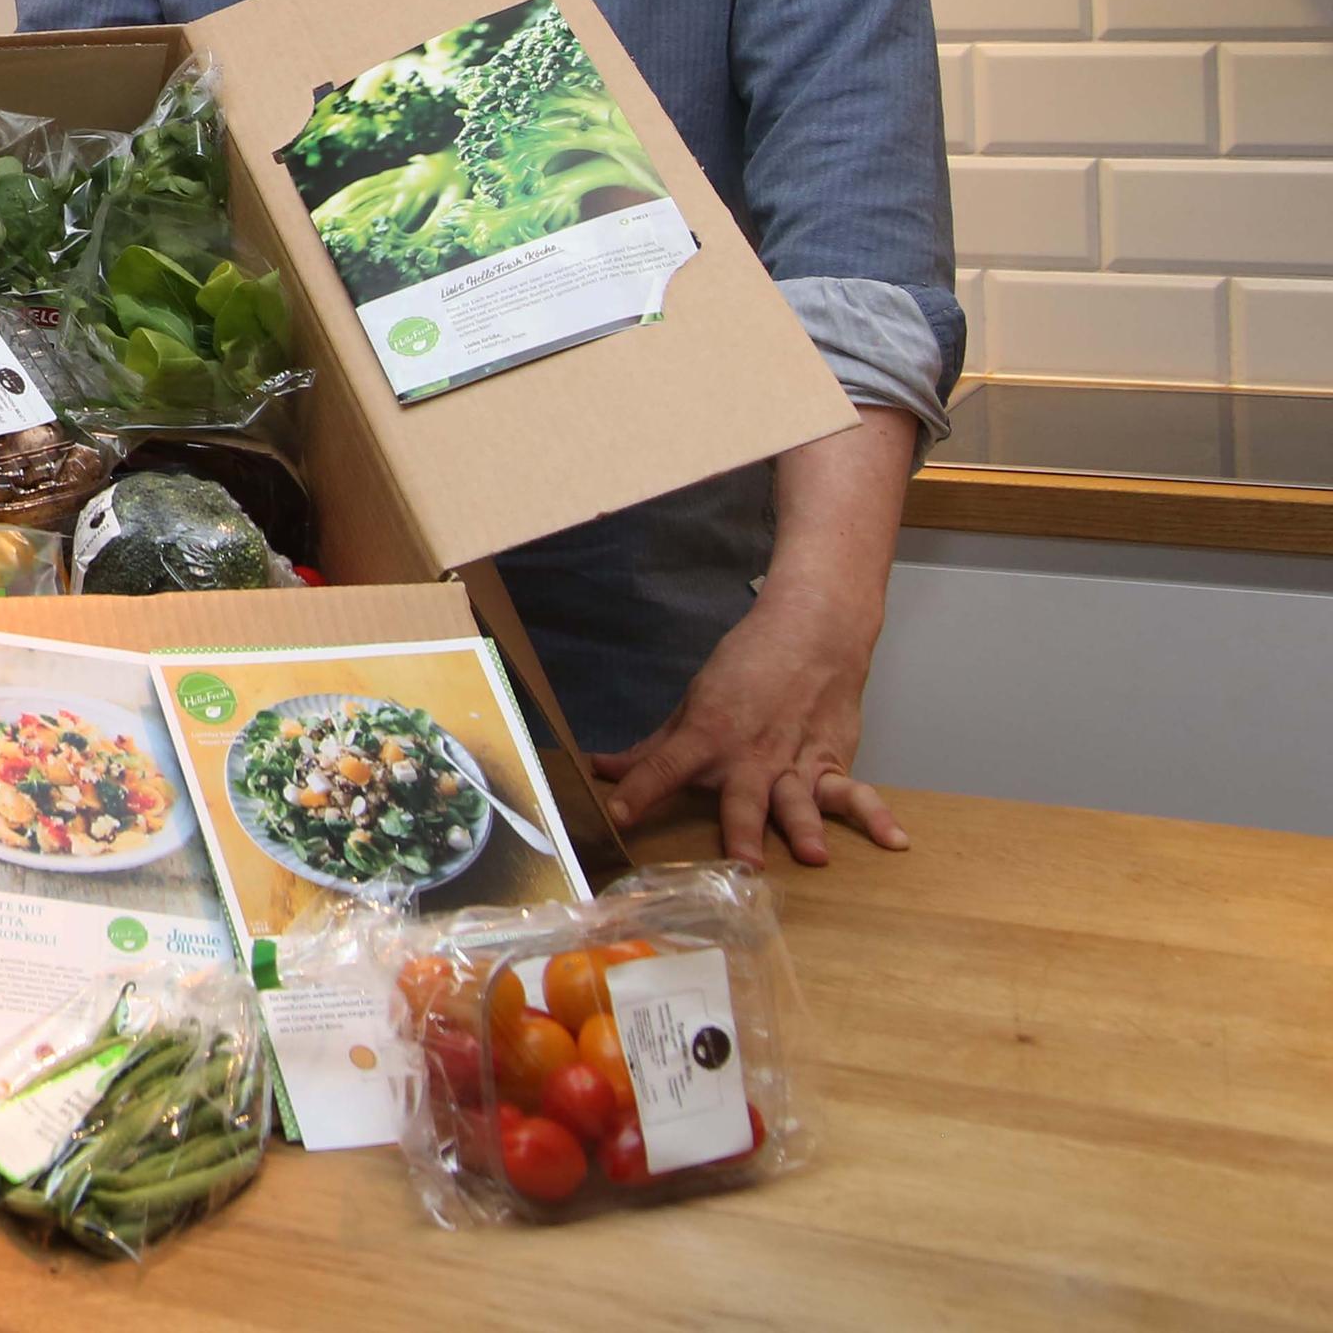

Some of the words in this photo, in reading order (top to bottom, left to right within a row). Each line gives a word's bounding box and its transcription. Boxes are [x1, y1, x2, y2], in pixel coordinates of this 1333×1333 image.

[440, 280, 465, 299] Liebe
[184, 687, 230, 708] HelloFresh
[18, 903, 45, 917] MIT
[167, 928, 222, 946] Jamie
[165, 940, 221, 959] Oliver
